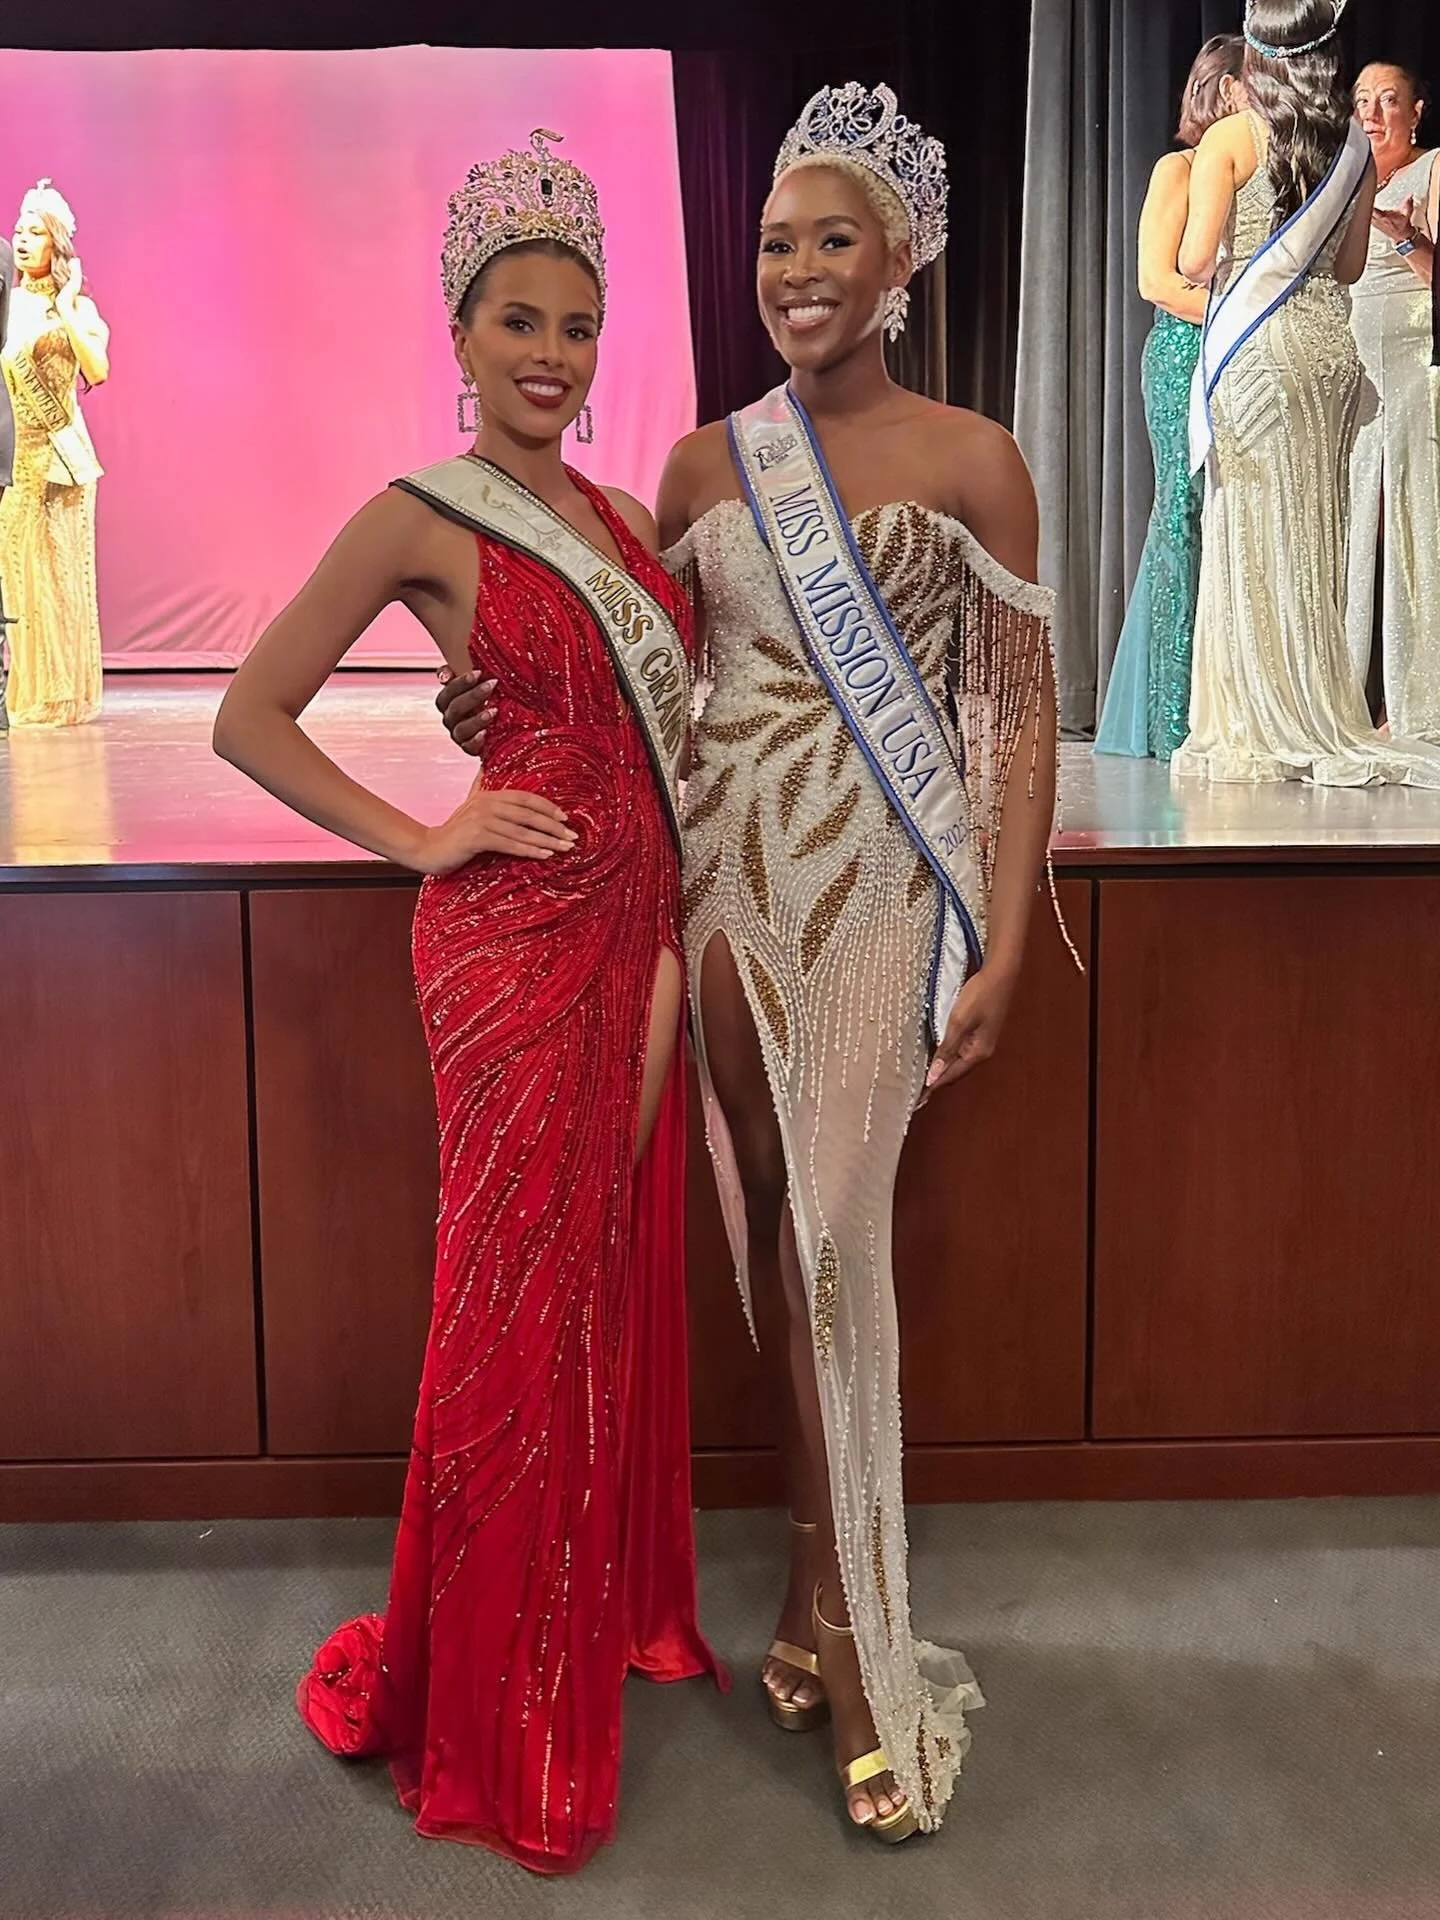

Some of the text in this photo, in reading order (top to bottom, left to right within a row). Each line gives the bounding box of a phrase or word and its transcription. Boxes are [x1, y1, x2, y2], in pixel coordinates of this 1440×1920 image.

[769, 483, 829, 556] MISS
[585, 568, 653, 645] MISS
[796, 556, 905, 718] MISSION
[881, 713, 940, 801] USA
